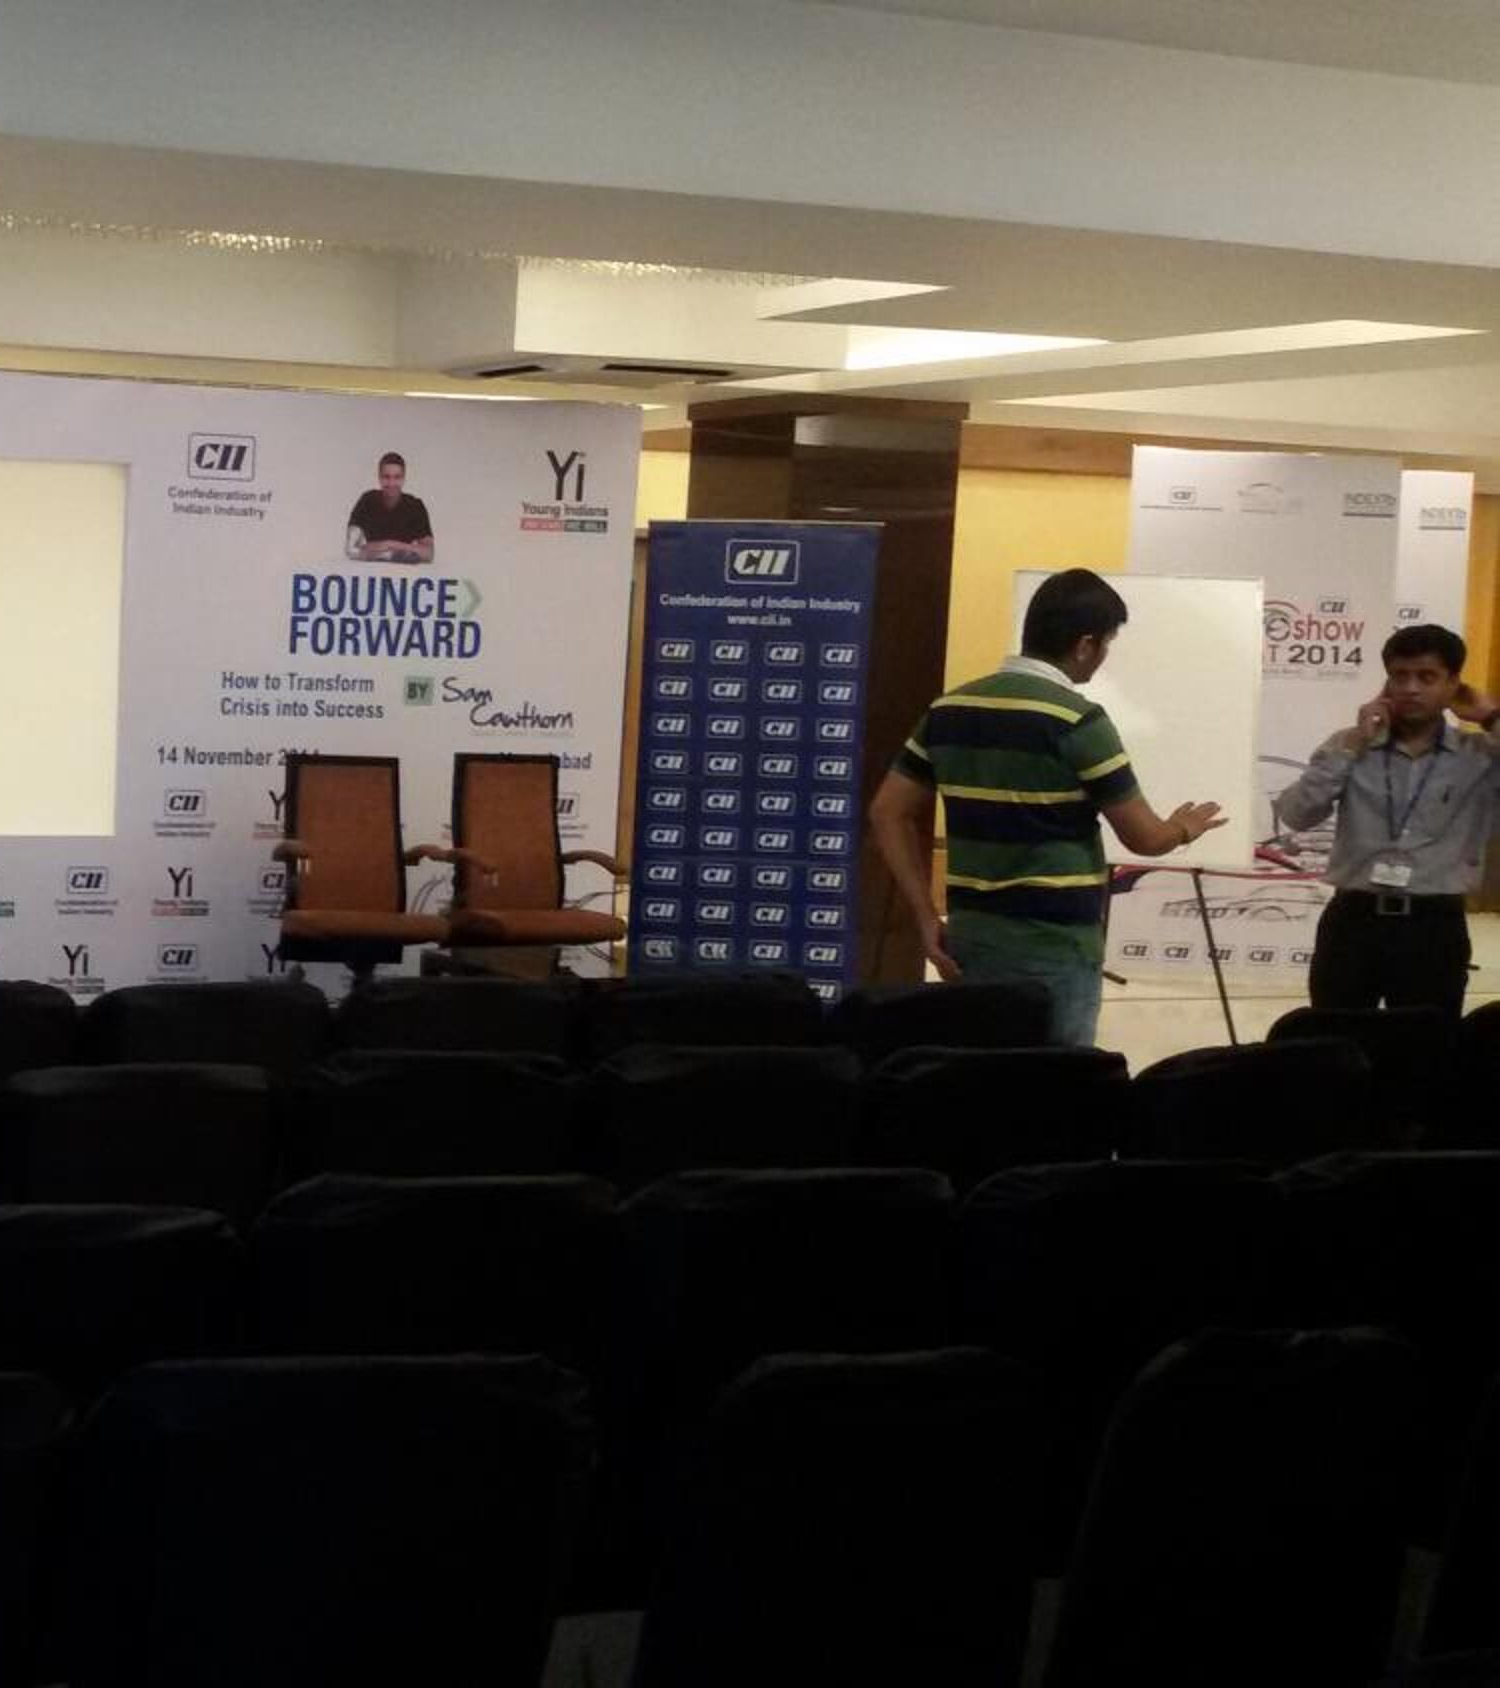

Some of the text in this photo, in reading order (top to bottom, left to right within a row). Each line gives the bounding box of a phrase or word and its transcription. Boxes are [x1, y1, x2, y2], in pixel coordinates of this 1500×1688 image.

[195, 443, 247, 471] CII
[547, 450, 586, 502] Yi
[733, 549, 791, 575] CII
[291, 574, 459, 619] BOUNCE
[659, 593, 861, 613] Confederation of Indian Industry
[727, 613, 792, 626] www.cii.in
[289, 617, 482, 659] FORWARD
[661, 644, 852, 662] CII CII CII CII
[1289, 645, 1363, 665] 2014
[221, 672, 375, 693] How to Transform
[407, 676, 493, 703] BY Sam
[659, 681, 851, 700] CII CII CII CII
[220, 698, 385, 719] Crisis into Success
[469, 701, 574, 729] Cawthorn
[657, 719, 848, 737] CII CII CII CII
[157, 746, 177, 765] 14
[184, 747, 274, 766] November
[655, 756, 847, 775] CII CII CII CII
[652, 793, 844, 812] CII CII CII CII
[651, 829, 843, 849] CII CII CII CII
[168, 868, 193, 897] Yi
[649, 867, 840, 887] CII CII CII CII
[647, 904, 838, 924] CII CII CII CII
[63, 945, 88, 976] Yi
[753, 945, 781, 959] CII
[809, 948, 837, 961] CII
